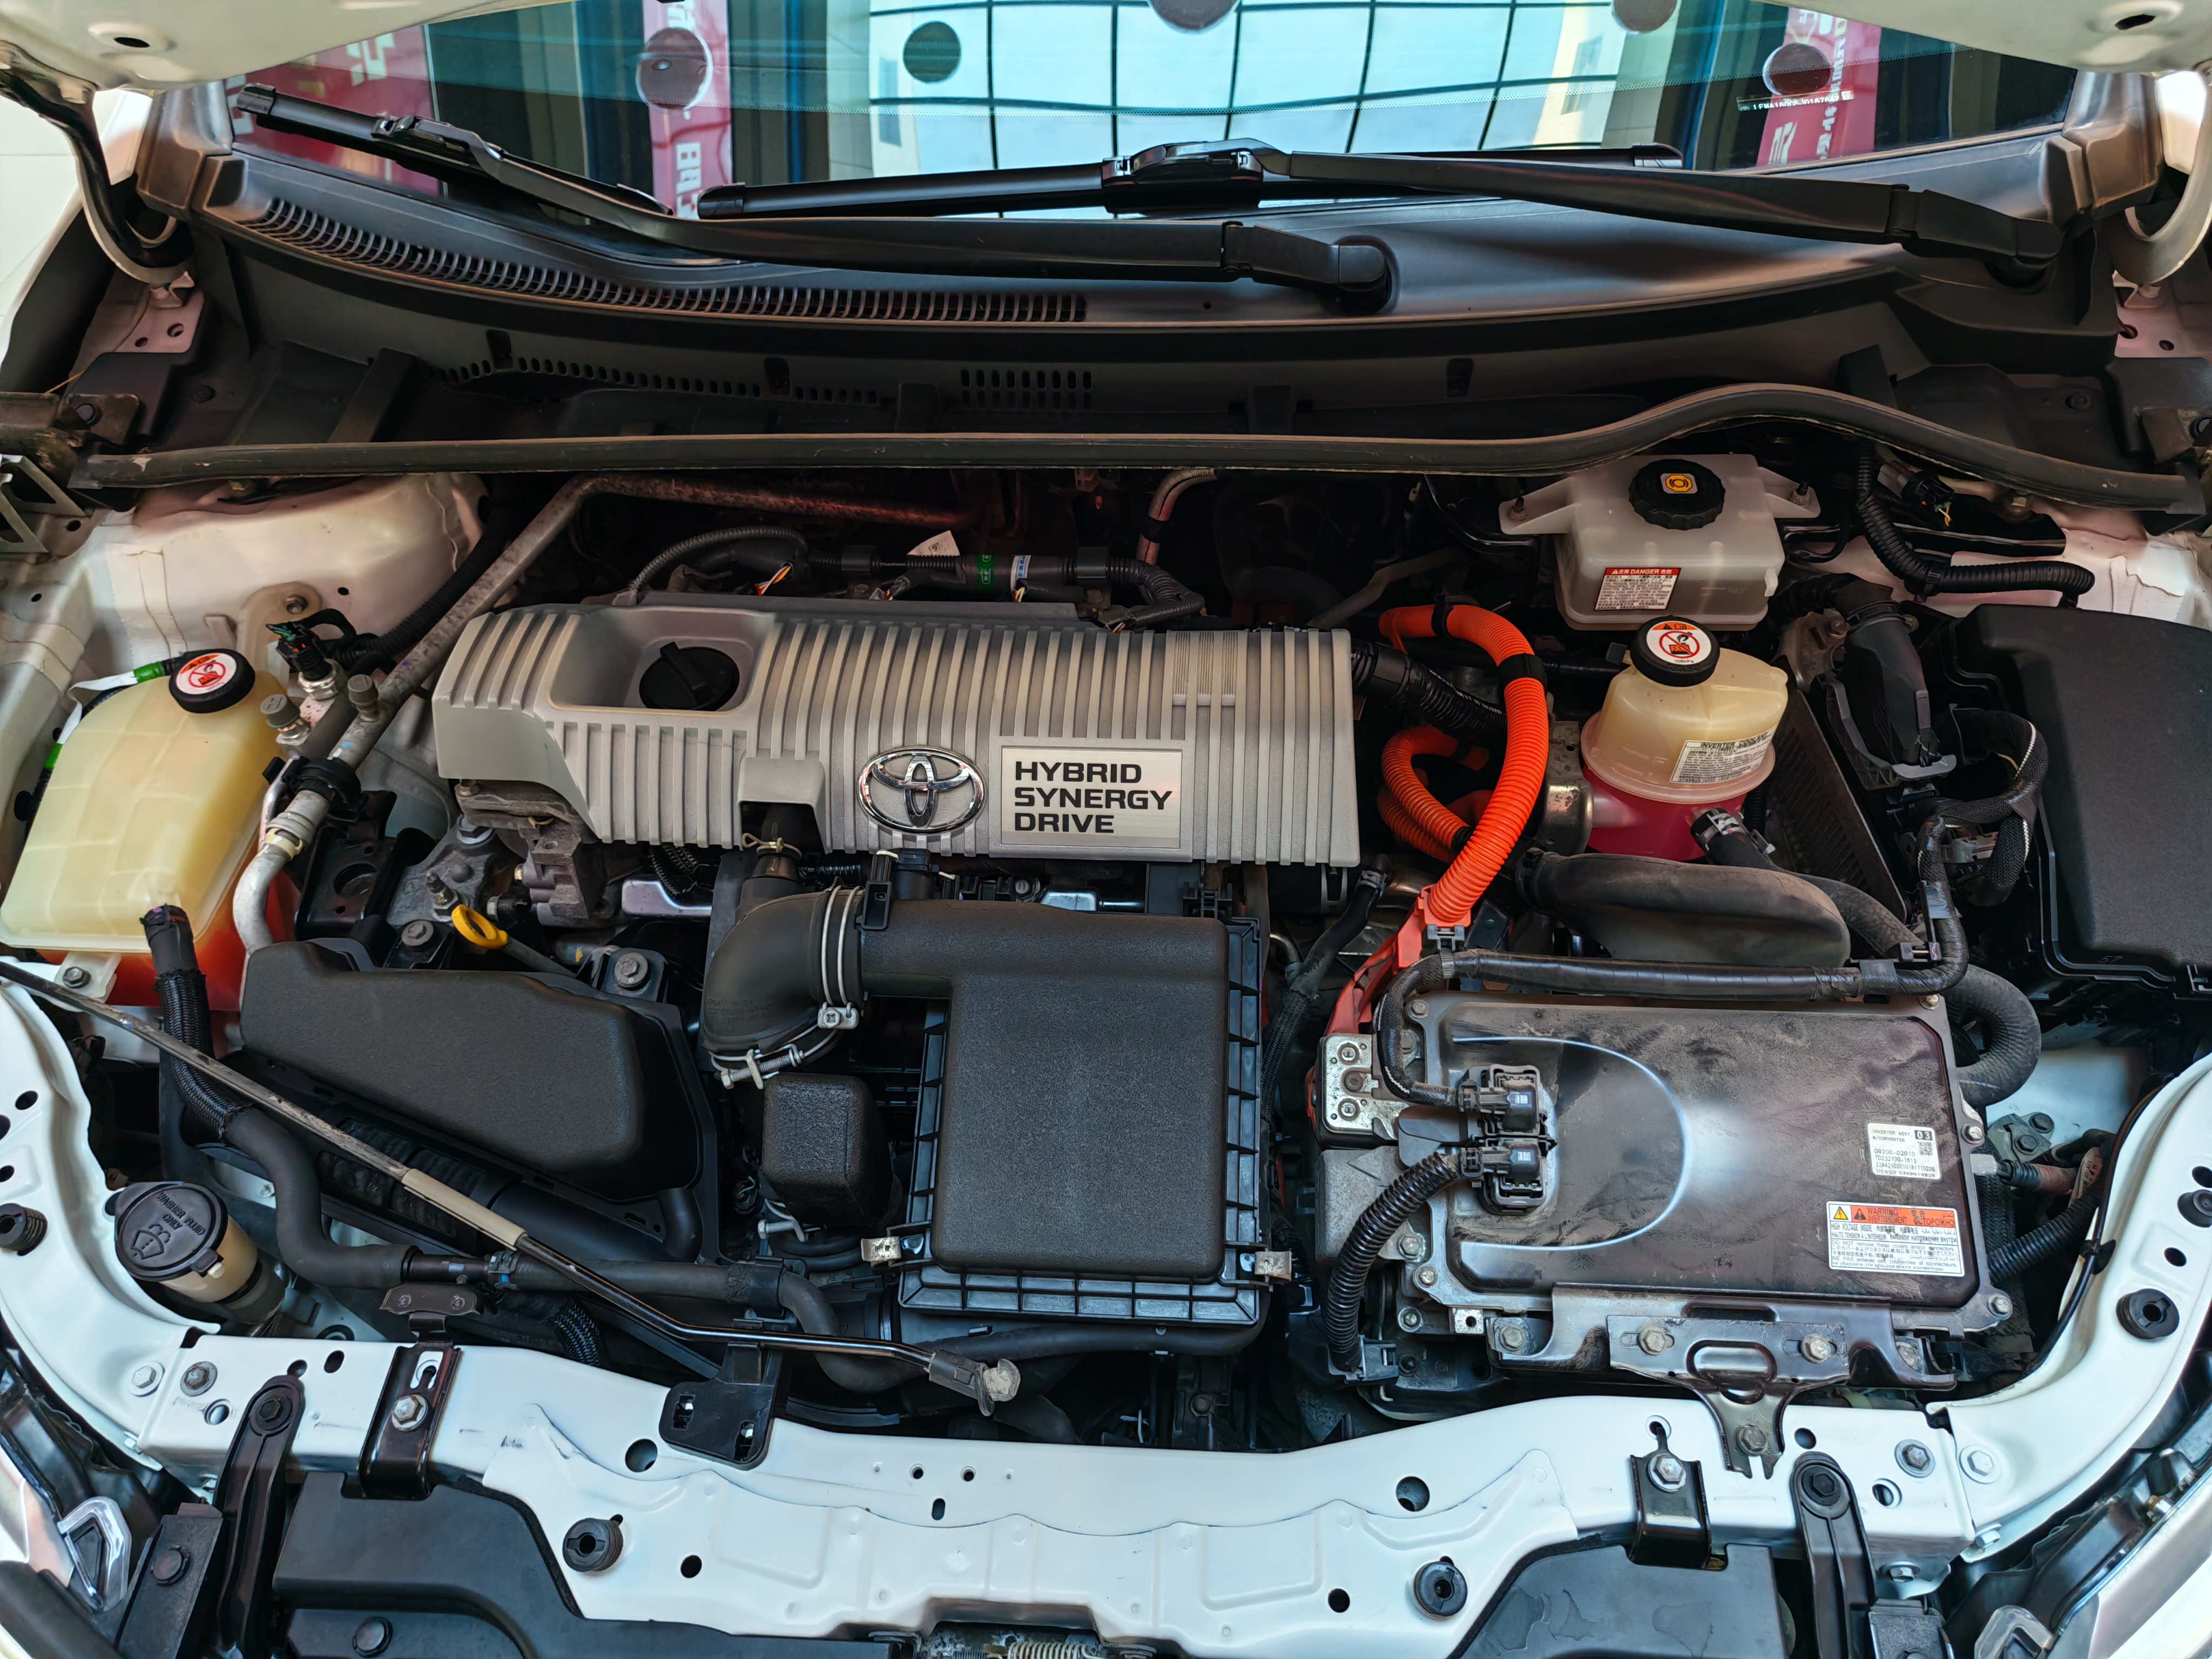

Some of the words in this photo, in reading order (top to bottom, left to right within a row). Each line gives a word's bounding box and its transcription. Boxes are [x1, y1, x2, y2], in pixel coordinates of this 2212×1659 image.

[1738, 732, 1769, 746] COOLANT
[1015, 761, 1142, 783] HYBRID
[1015, 787, 1174, 811] SYNERGY
[1015, 813, 1115, 833] DRIVE
[1917, 1131, 1931, 1139] 03
[1874, 1148, 1915, 1157] G9200-02010
[157, 1191, 186, 1219] WASHER
[184, 1217, 206, 1236] FLUID
[1867, 1207, 1899, 1216] WARNING
[163, 1213, 183, 1231] ONLY
[1842, 1223, 1858, 1231] VOLTAGE
